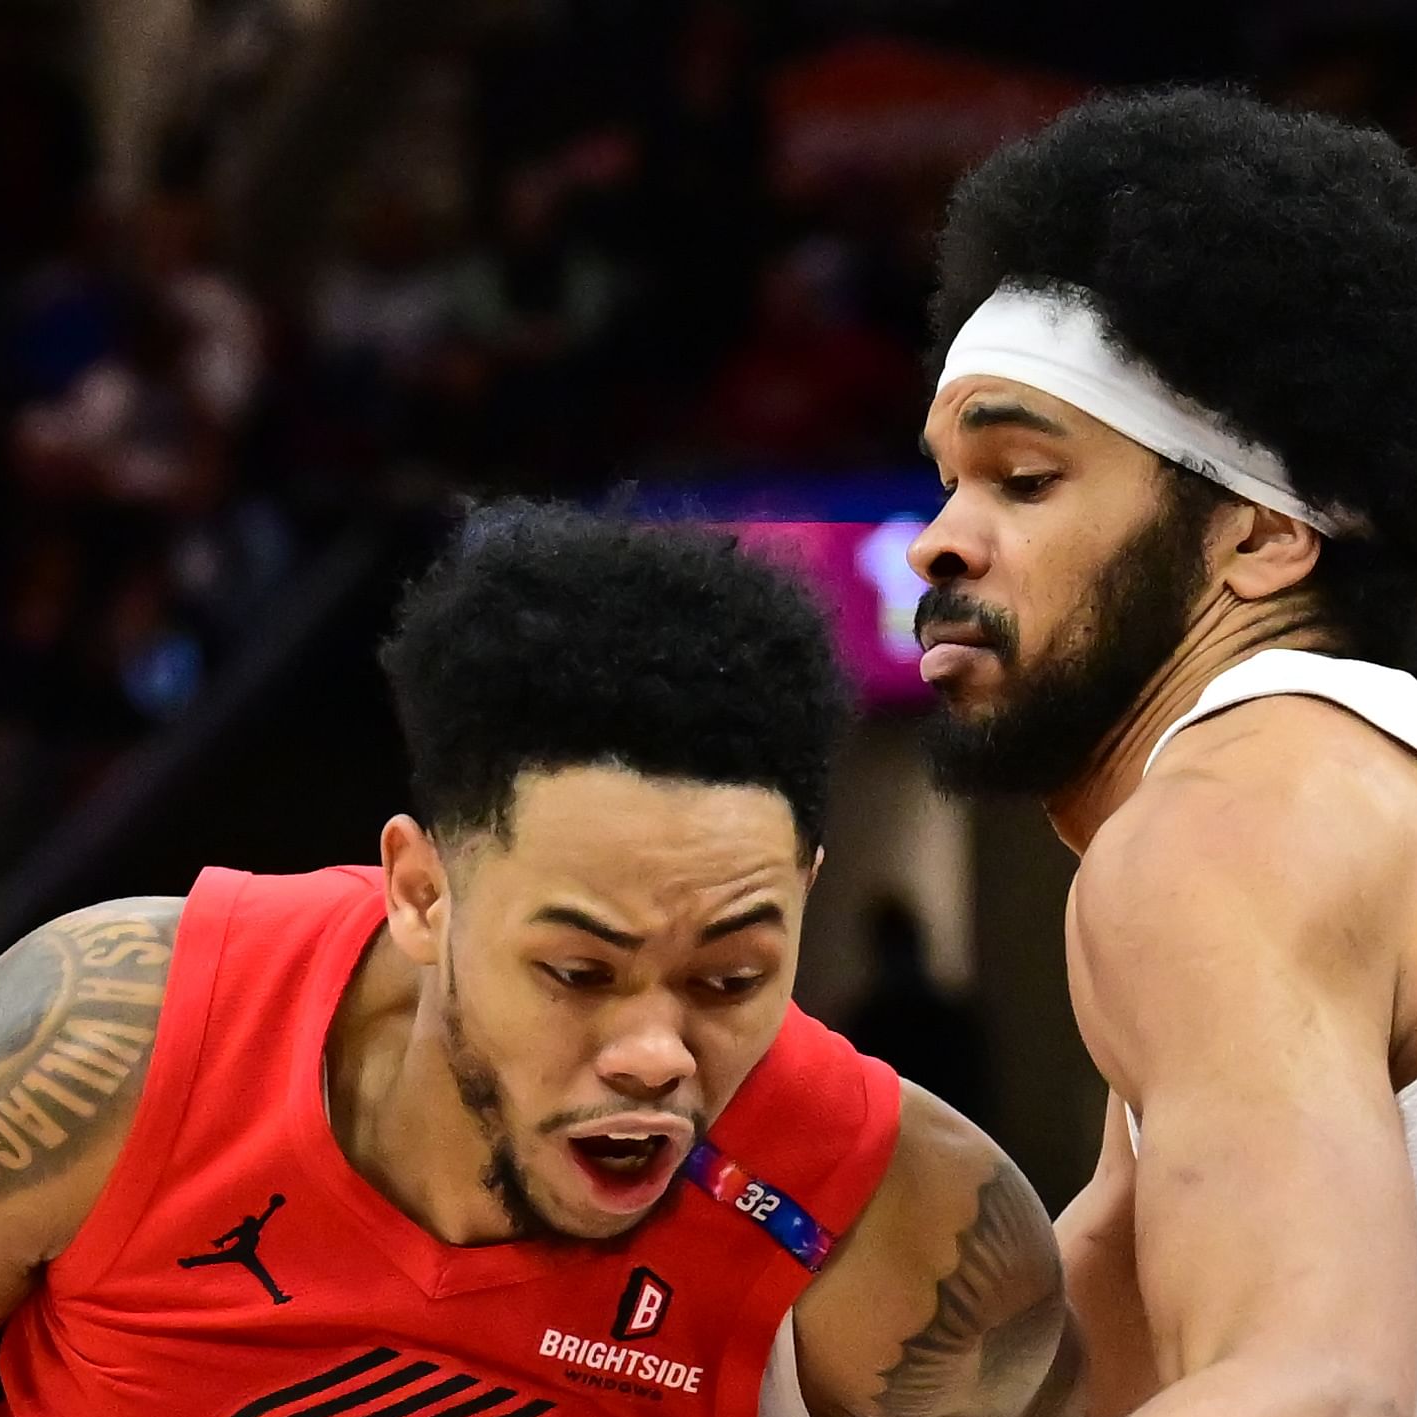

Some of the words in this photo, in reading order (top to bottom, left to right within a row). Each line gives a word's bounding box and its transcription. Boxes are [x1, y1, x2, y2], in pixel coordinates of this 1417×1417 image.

[735, 1183, 780, 1221] 32
[539, 1329, 704, 1393] BRIGHTSIDE
[564, 1369, 663, 1400] WINDOWS
